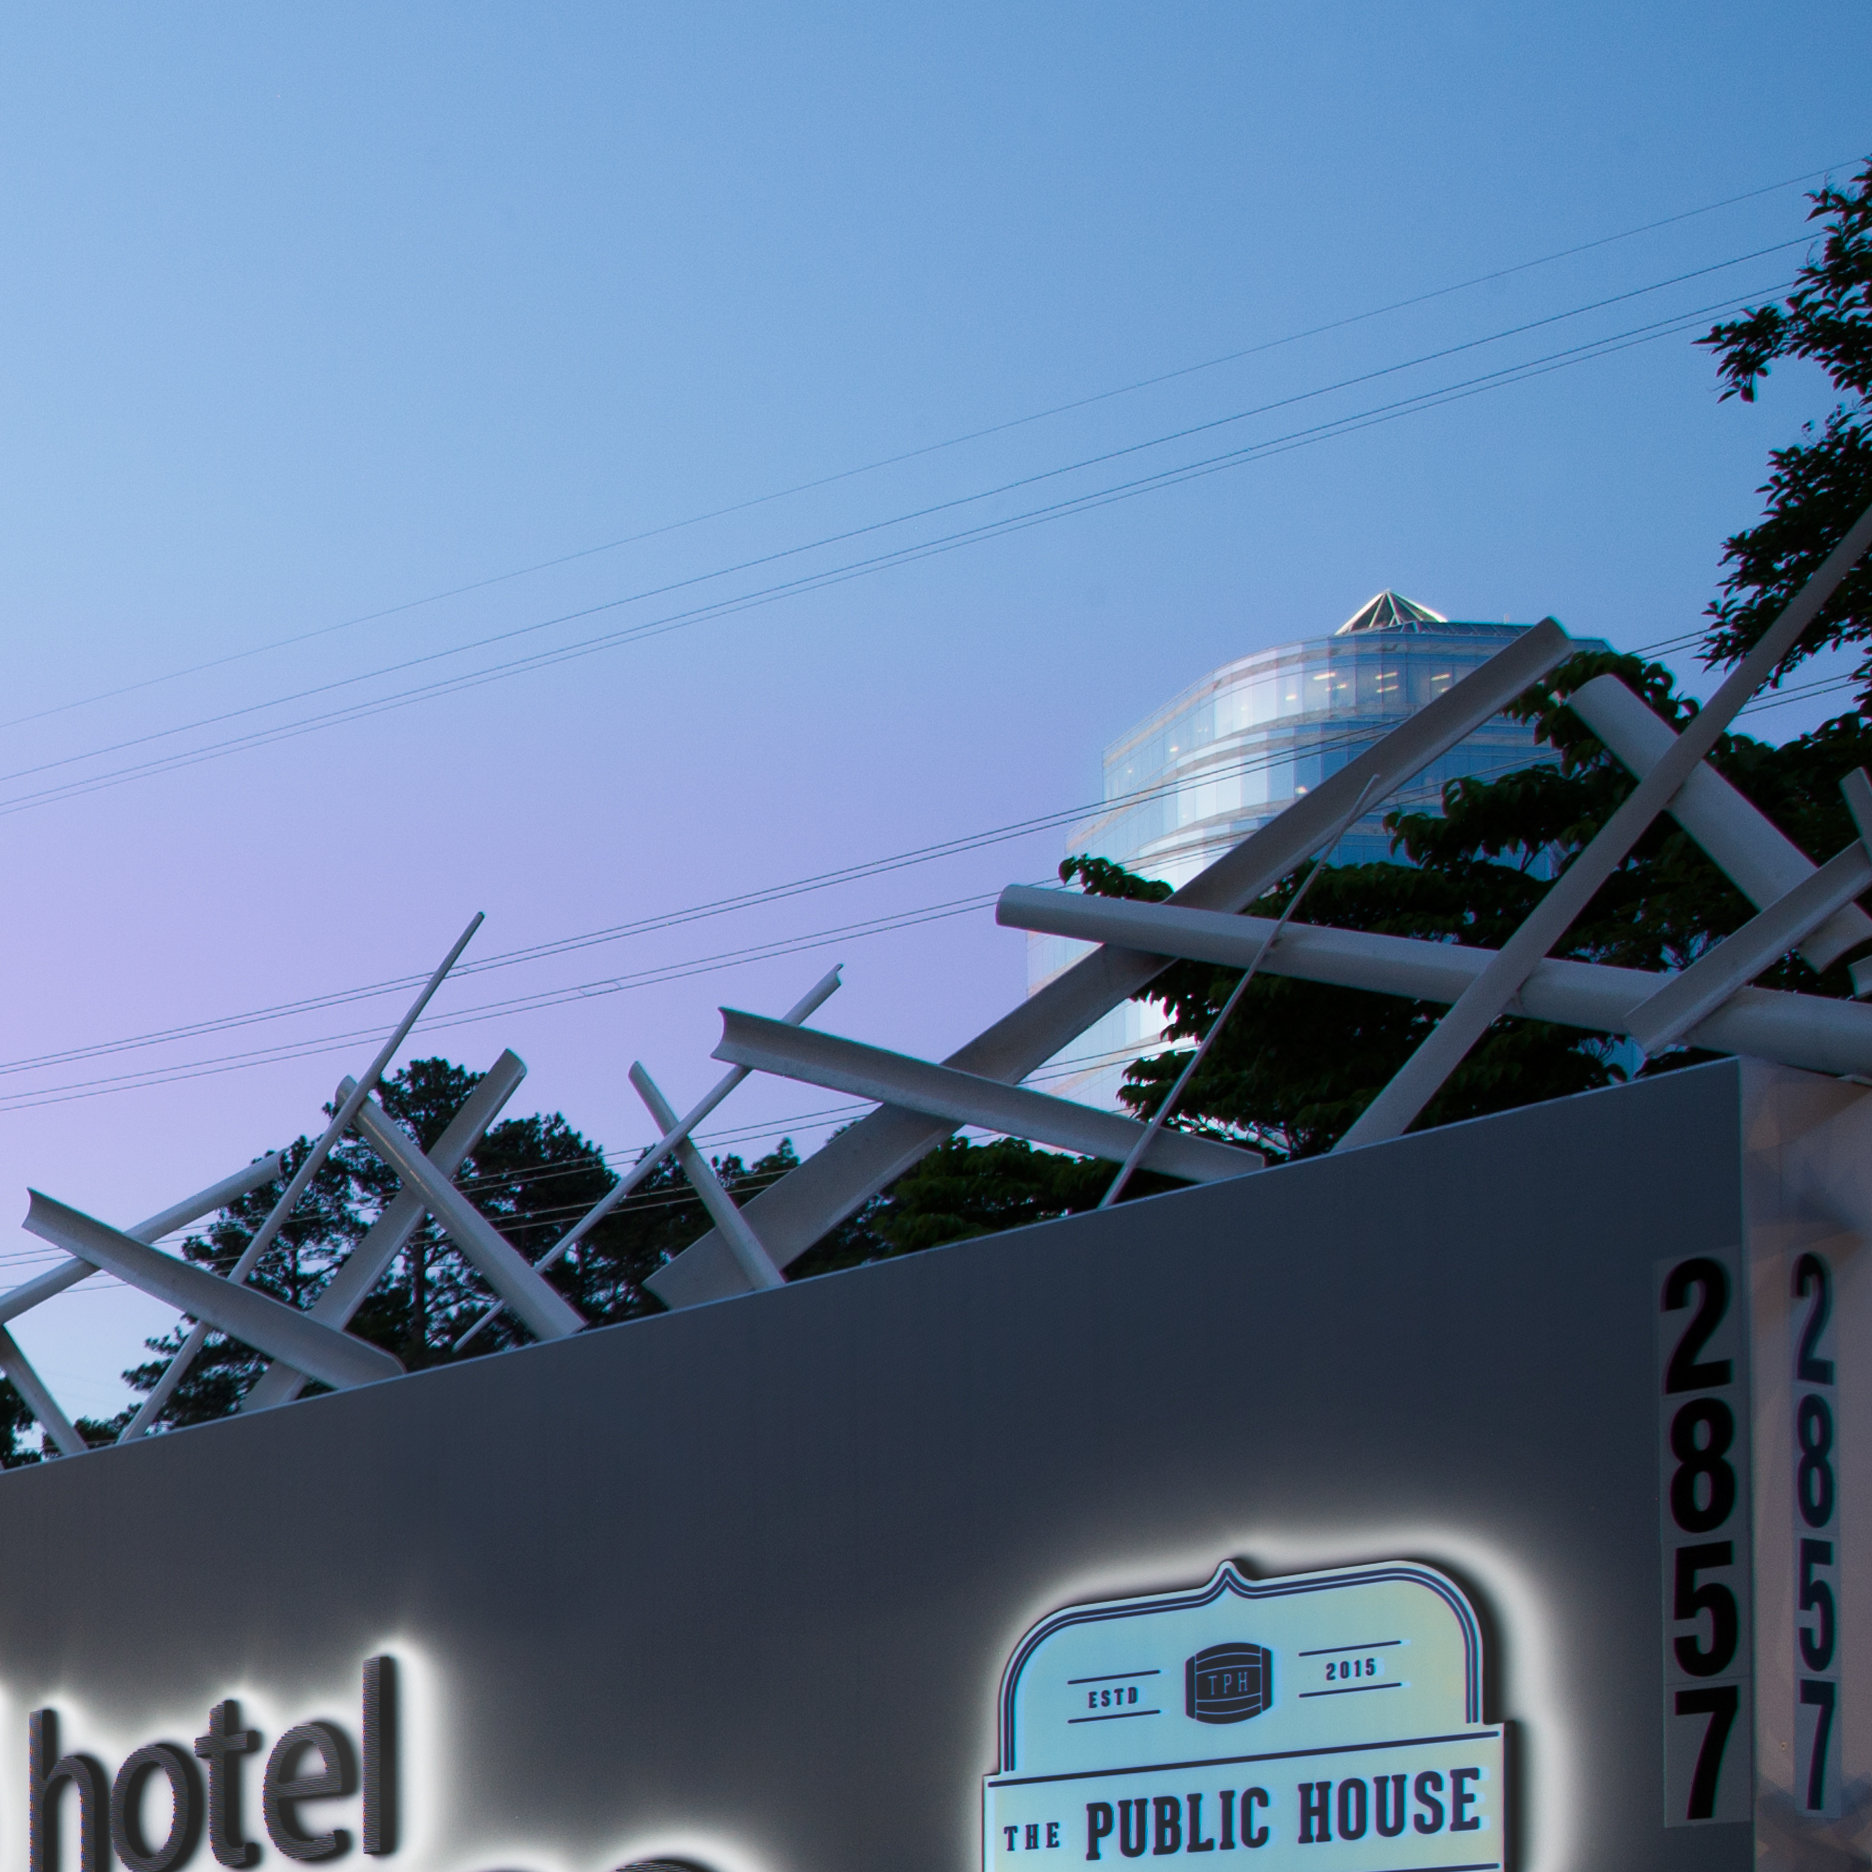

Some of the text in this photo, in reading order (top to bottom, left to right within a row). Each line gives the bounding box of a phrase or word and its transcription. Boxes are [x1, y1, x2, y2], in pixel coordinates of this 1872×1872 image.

[1659, 1256, 1741, 1820] 28557
[1789, 1250, 1837, 1812] 28557
[1087, 1686, 1140, 1709] ESTD
[1207, 1671, 1249, 1697] TPH
[1324, 1657, 1377, 1681] 2015
[1003, 1767, 1481, 1862] THE PUBLIC HOUSE
